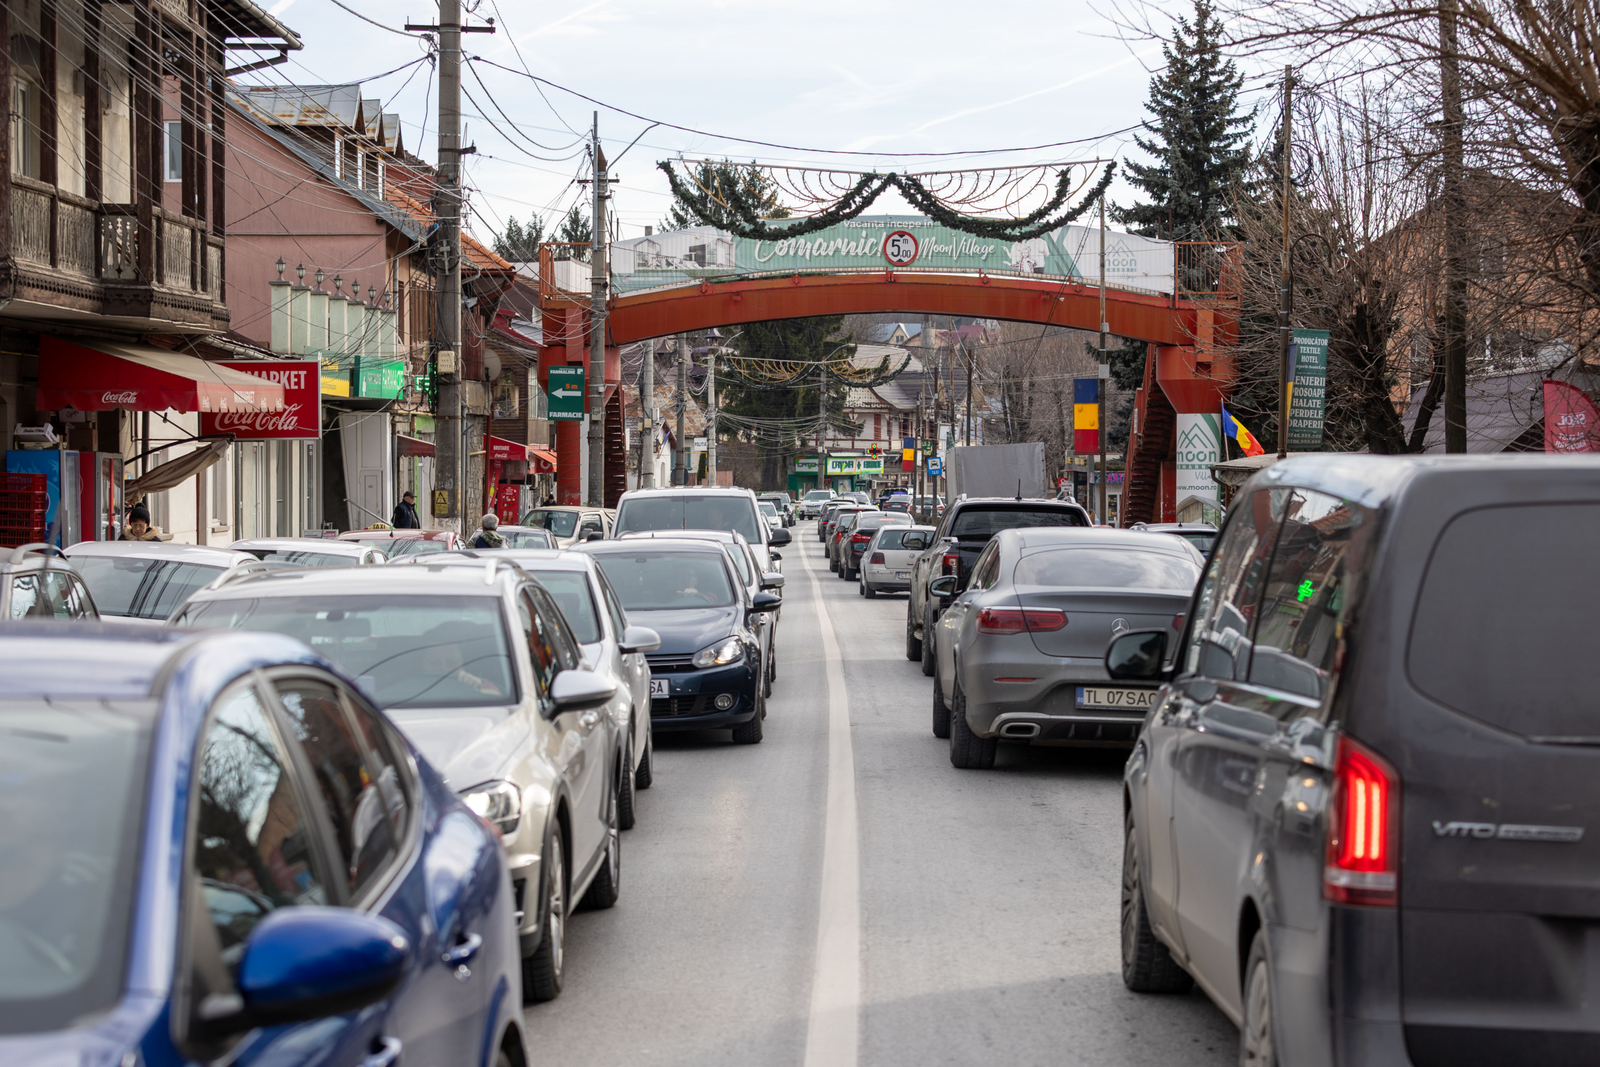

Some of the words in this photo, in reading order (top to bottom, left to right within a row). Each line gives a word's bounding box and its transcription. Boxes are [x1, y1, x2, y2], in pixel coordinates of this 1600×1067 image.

[1300, 346, 1321, 355] TEXTILE
[1301, 355, 1319, 364] HOTEL
[1292, 386, 1326, 398] ROSOAPE
[1292, 398, 1322, 408] HALATE
[549, 411, 583, 419] FARMACIE
[1290, 408, 1323, 419] PERDELE
[1085, 690, 1102, 704] TL
[1107, 691, 1124, 705] 07
[1432, 820, 1497, 838] VITO
